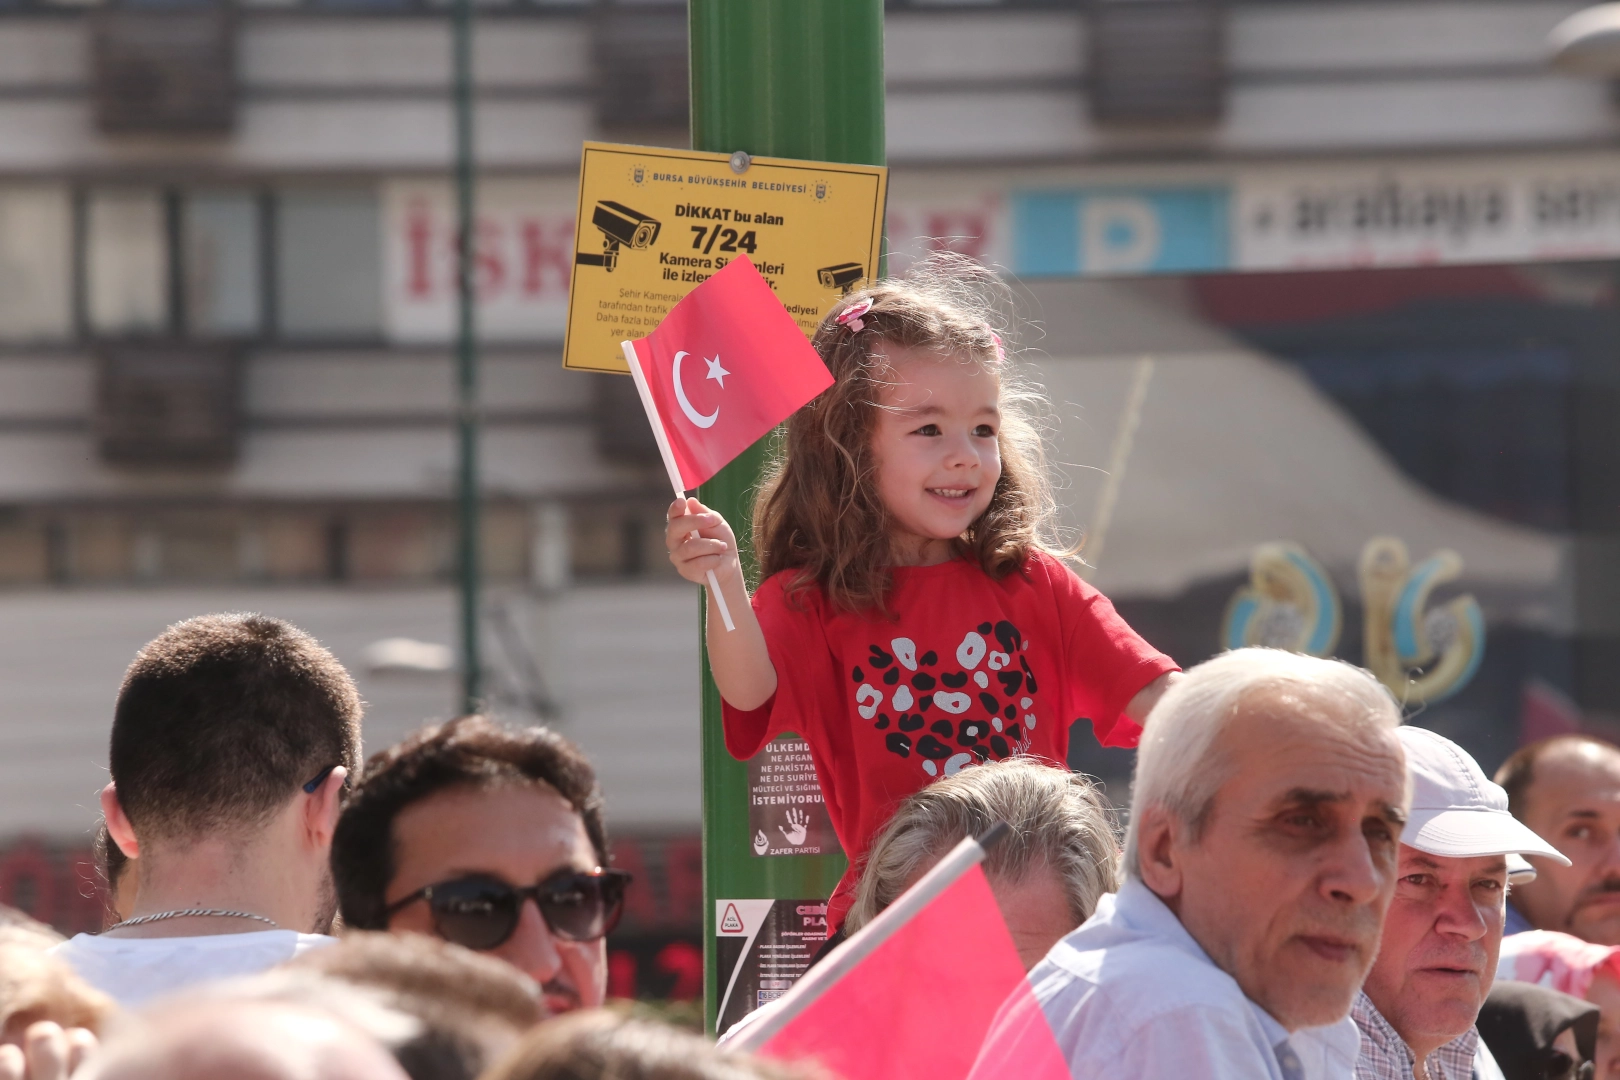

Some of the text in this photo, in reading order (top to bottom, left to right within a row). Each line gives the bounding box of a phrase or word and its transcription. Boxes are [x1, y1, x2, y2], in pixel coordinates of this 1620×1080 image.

[653, 173, 807, 194] BURSA BÜYÜKŞEHİR BELEDİYESİ
[675, 203, 784, 226] DİKKAT bu alan
[690, 224, 757, 255] 7/24
[659, 252, 712, 269] Kamera
[662, 268, 679, 282] ile
[598, 299, 643, 312] tarafından
[645, 303, 668, 314] trafik
[596, 311, 619, 323] Daha
[621, 314, 642, 325] fazla
[610, 328, 625, 337] yer
[626, 328, 645, 338] alan
[771, 754, 782, 763] NE
[761, 765, 772, 773] NE
[760, 772, 818, 783] NE DE SURİYE
[752, 784, 783, 793] MÜLTECİ
[770, 848, 793, 856] ZAFER
